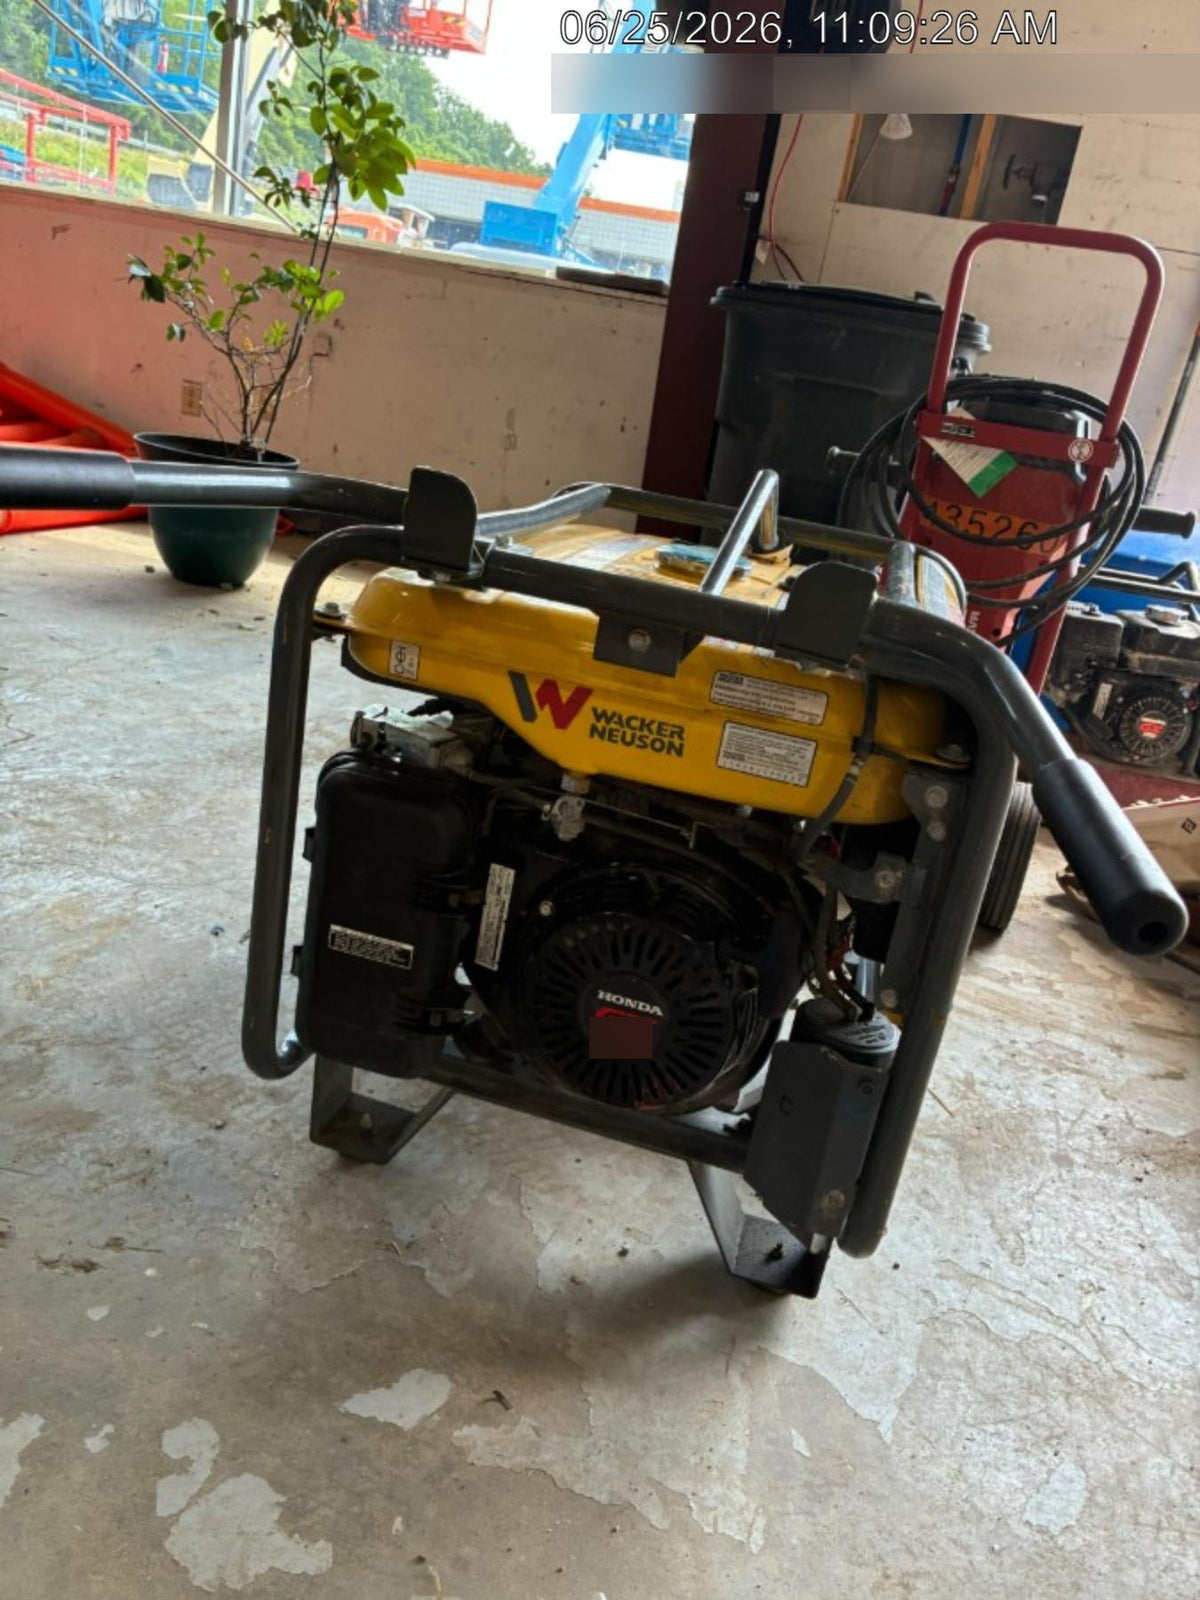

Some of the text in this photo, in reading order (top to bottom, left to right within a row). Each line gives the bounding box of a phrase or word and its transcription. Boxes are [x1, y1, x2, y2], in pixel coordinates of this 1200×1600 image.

[588, 723, 685, 758] NEUSON
[591, 706, 685, 741] WACKER
[597, 989, 664, 1017] HONDA
